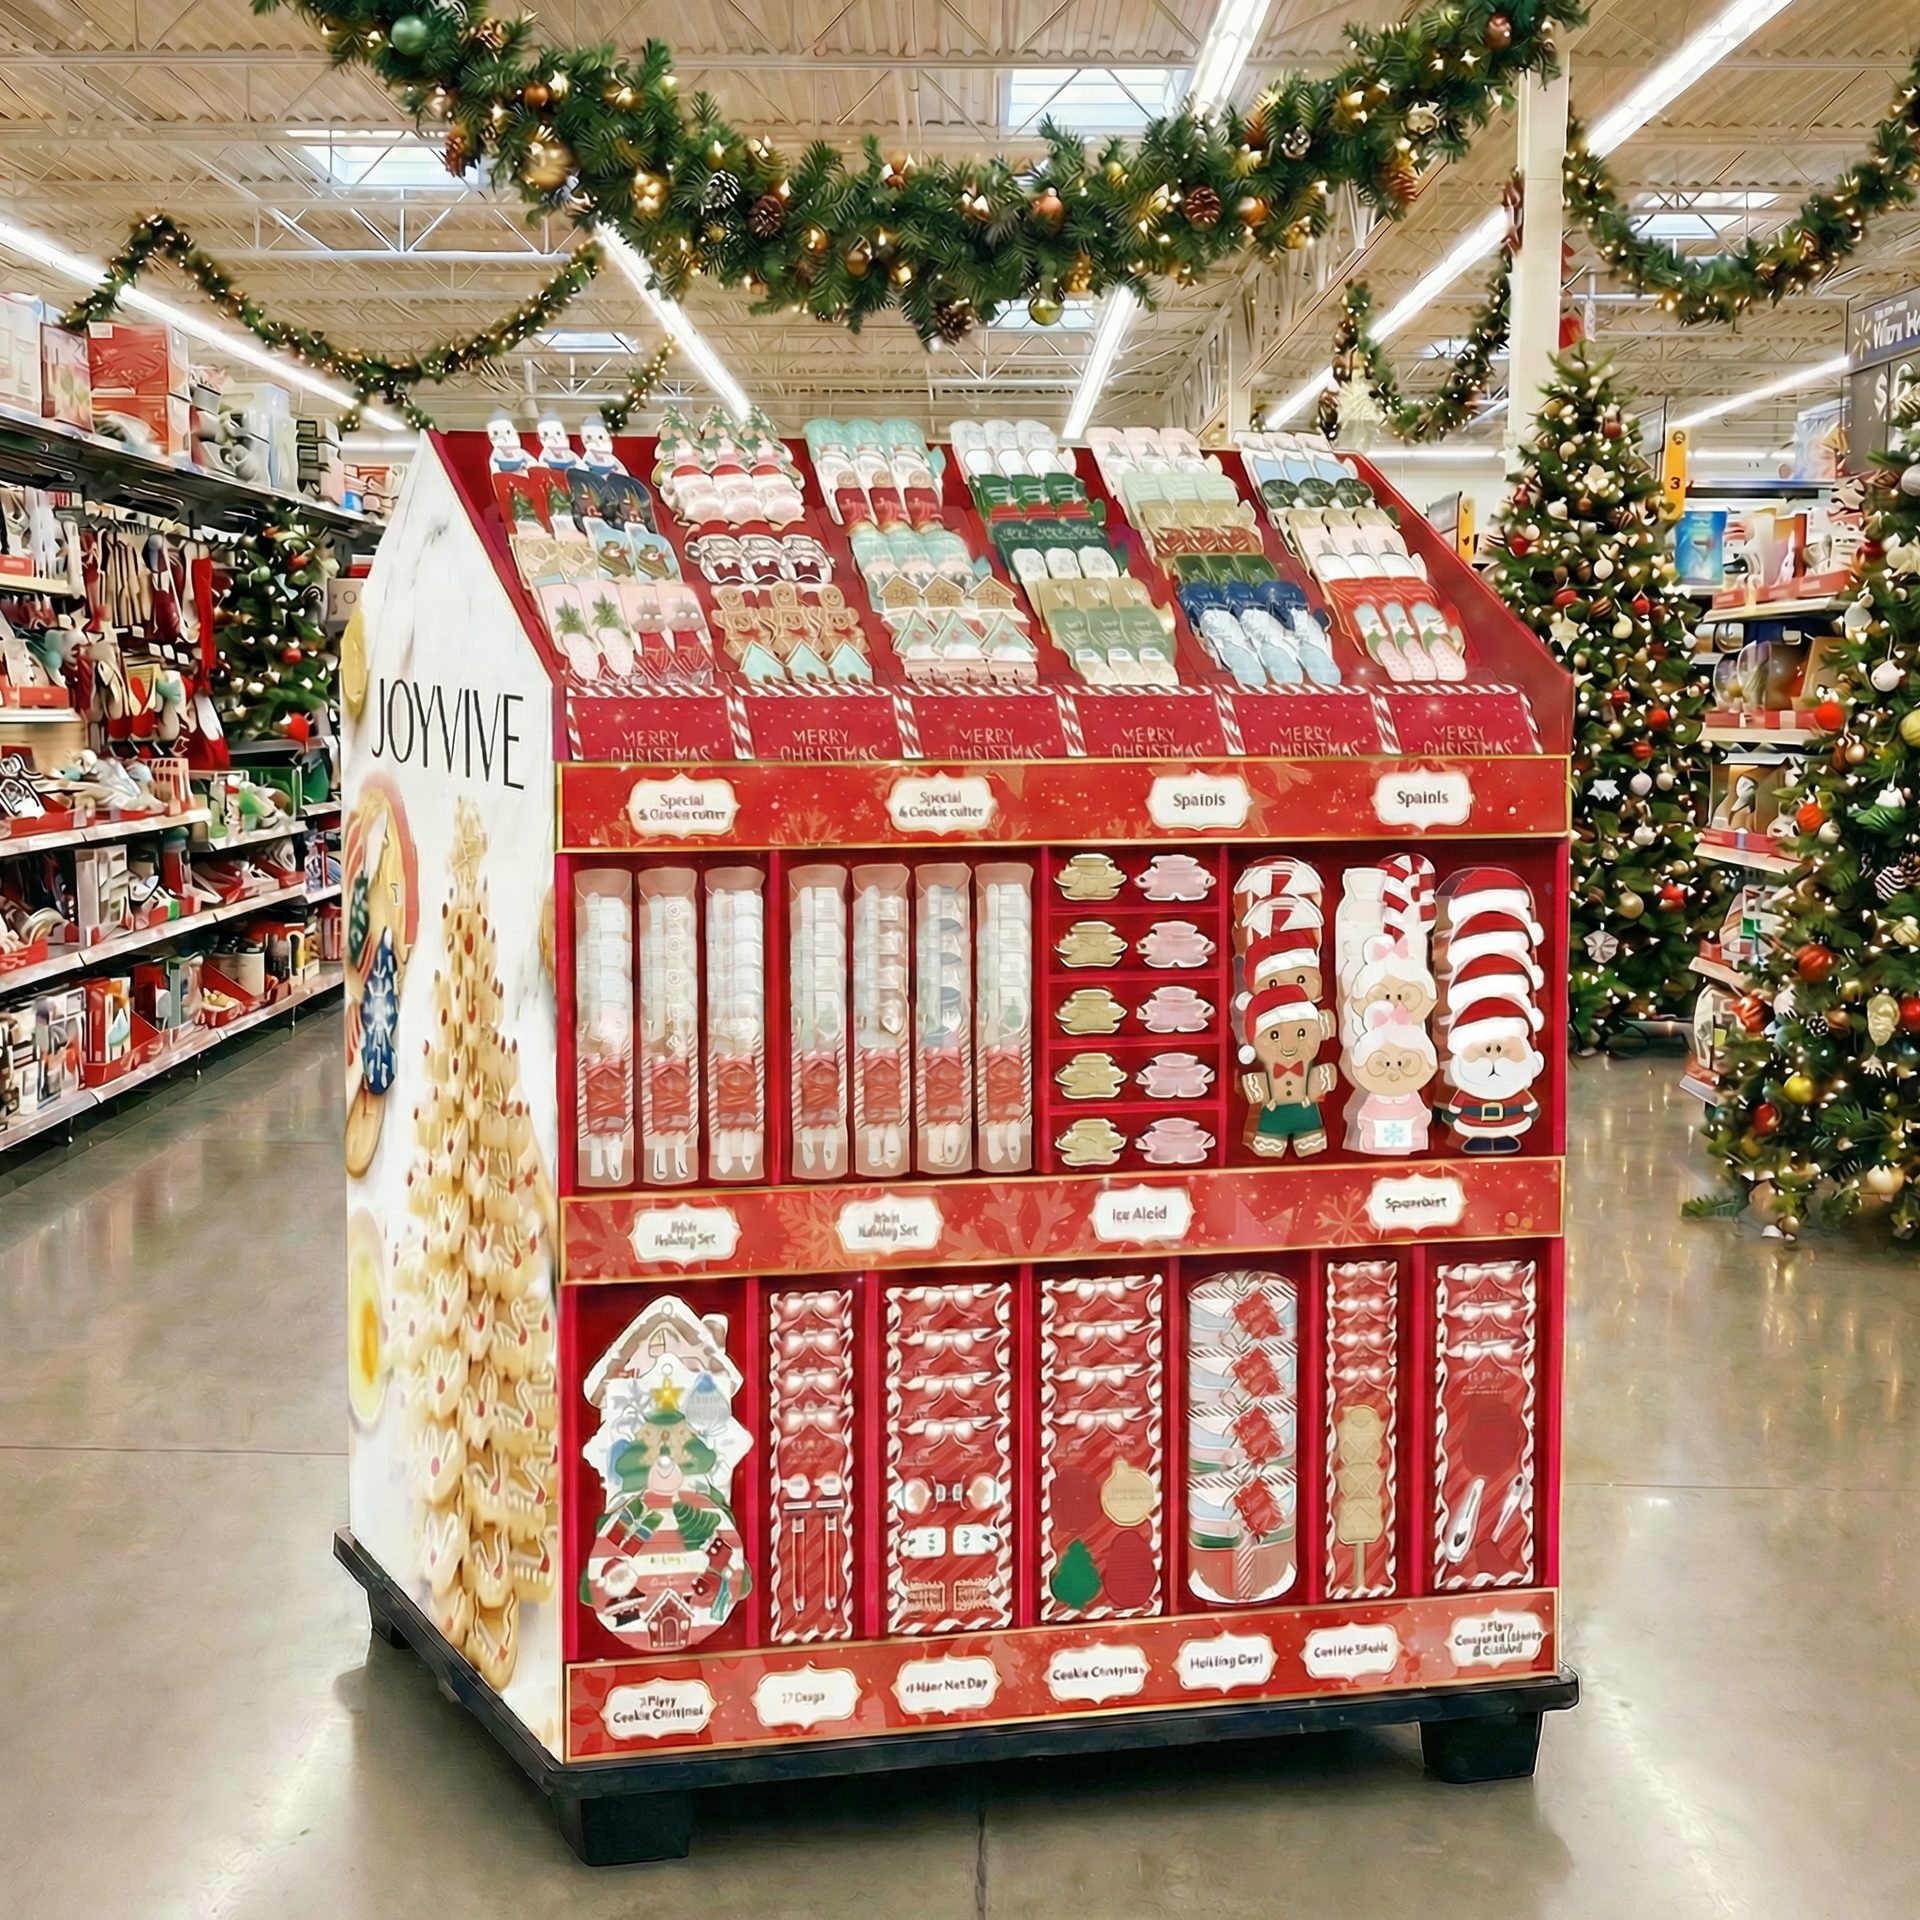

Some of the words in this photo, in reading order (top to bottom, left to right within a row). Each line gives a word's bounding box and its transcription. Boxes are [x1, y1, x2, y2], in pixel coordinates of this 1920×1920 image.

[1670, 476, 1681, 490] 3
[371, 678, 525, 790] JOYVIVE
[621, 729, 681, 746] MERRY
[792, 729, 849, 745] MERRY
[959, 728, 1015, 743] MERRY
[1121, 727, 1176, 742] MERRY
[1279, 726, 1334, 741] MERRY
[1433, 725, 1485, 741] MERRY
[610, 744, 712, 761] CHRISTMAS
[780, 744, 880, 761] CHRISTMAS
[949, 743, 1045, 760] CHRISTMAS
[1112, 742, 1204, 759] CHRISTMAS
[1270, 740, 1362, 757] CHRISTMAS
[1423, 739, 1514, 756] CHRISTMAS
